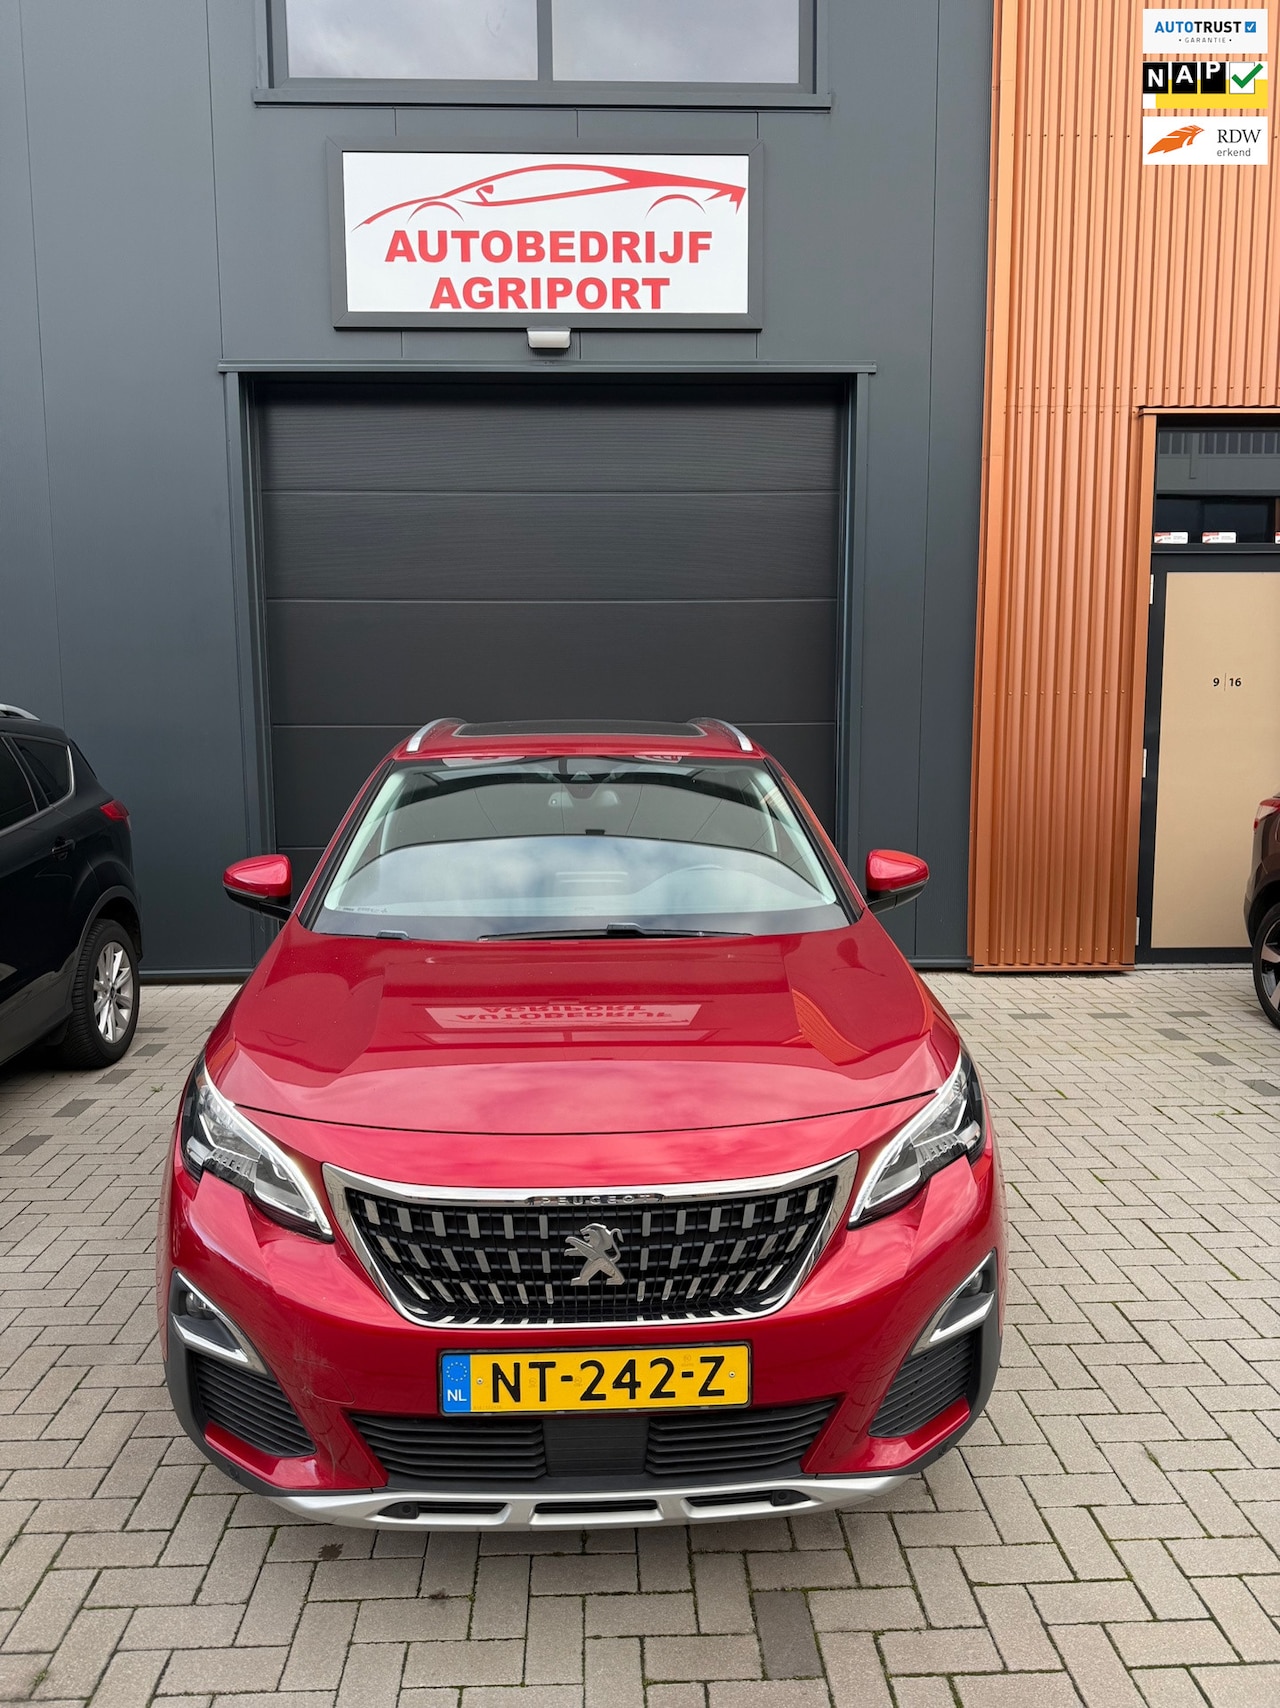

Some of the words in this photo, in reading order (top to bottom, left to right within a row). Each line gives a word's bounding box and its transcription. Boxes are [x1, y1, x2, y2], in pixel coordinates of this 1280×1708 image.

[385, 230, 713, 264] AUTOBEDRIJF
[430, 276, 670, 310] AGRIPORT
[1212, 677, 1220, 687] 9
[1228, 677, 1242, 687] 16
[447, 1389, 467, 1402] NL
[491, 1355, 725, 1403] NT-242-Z
